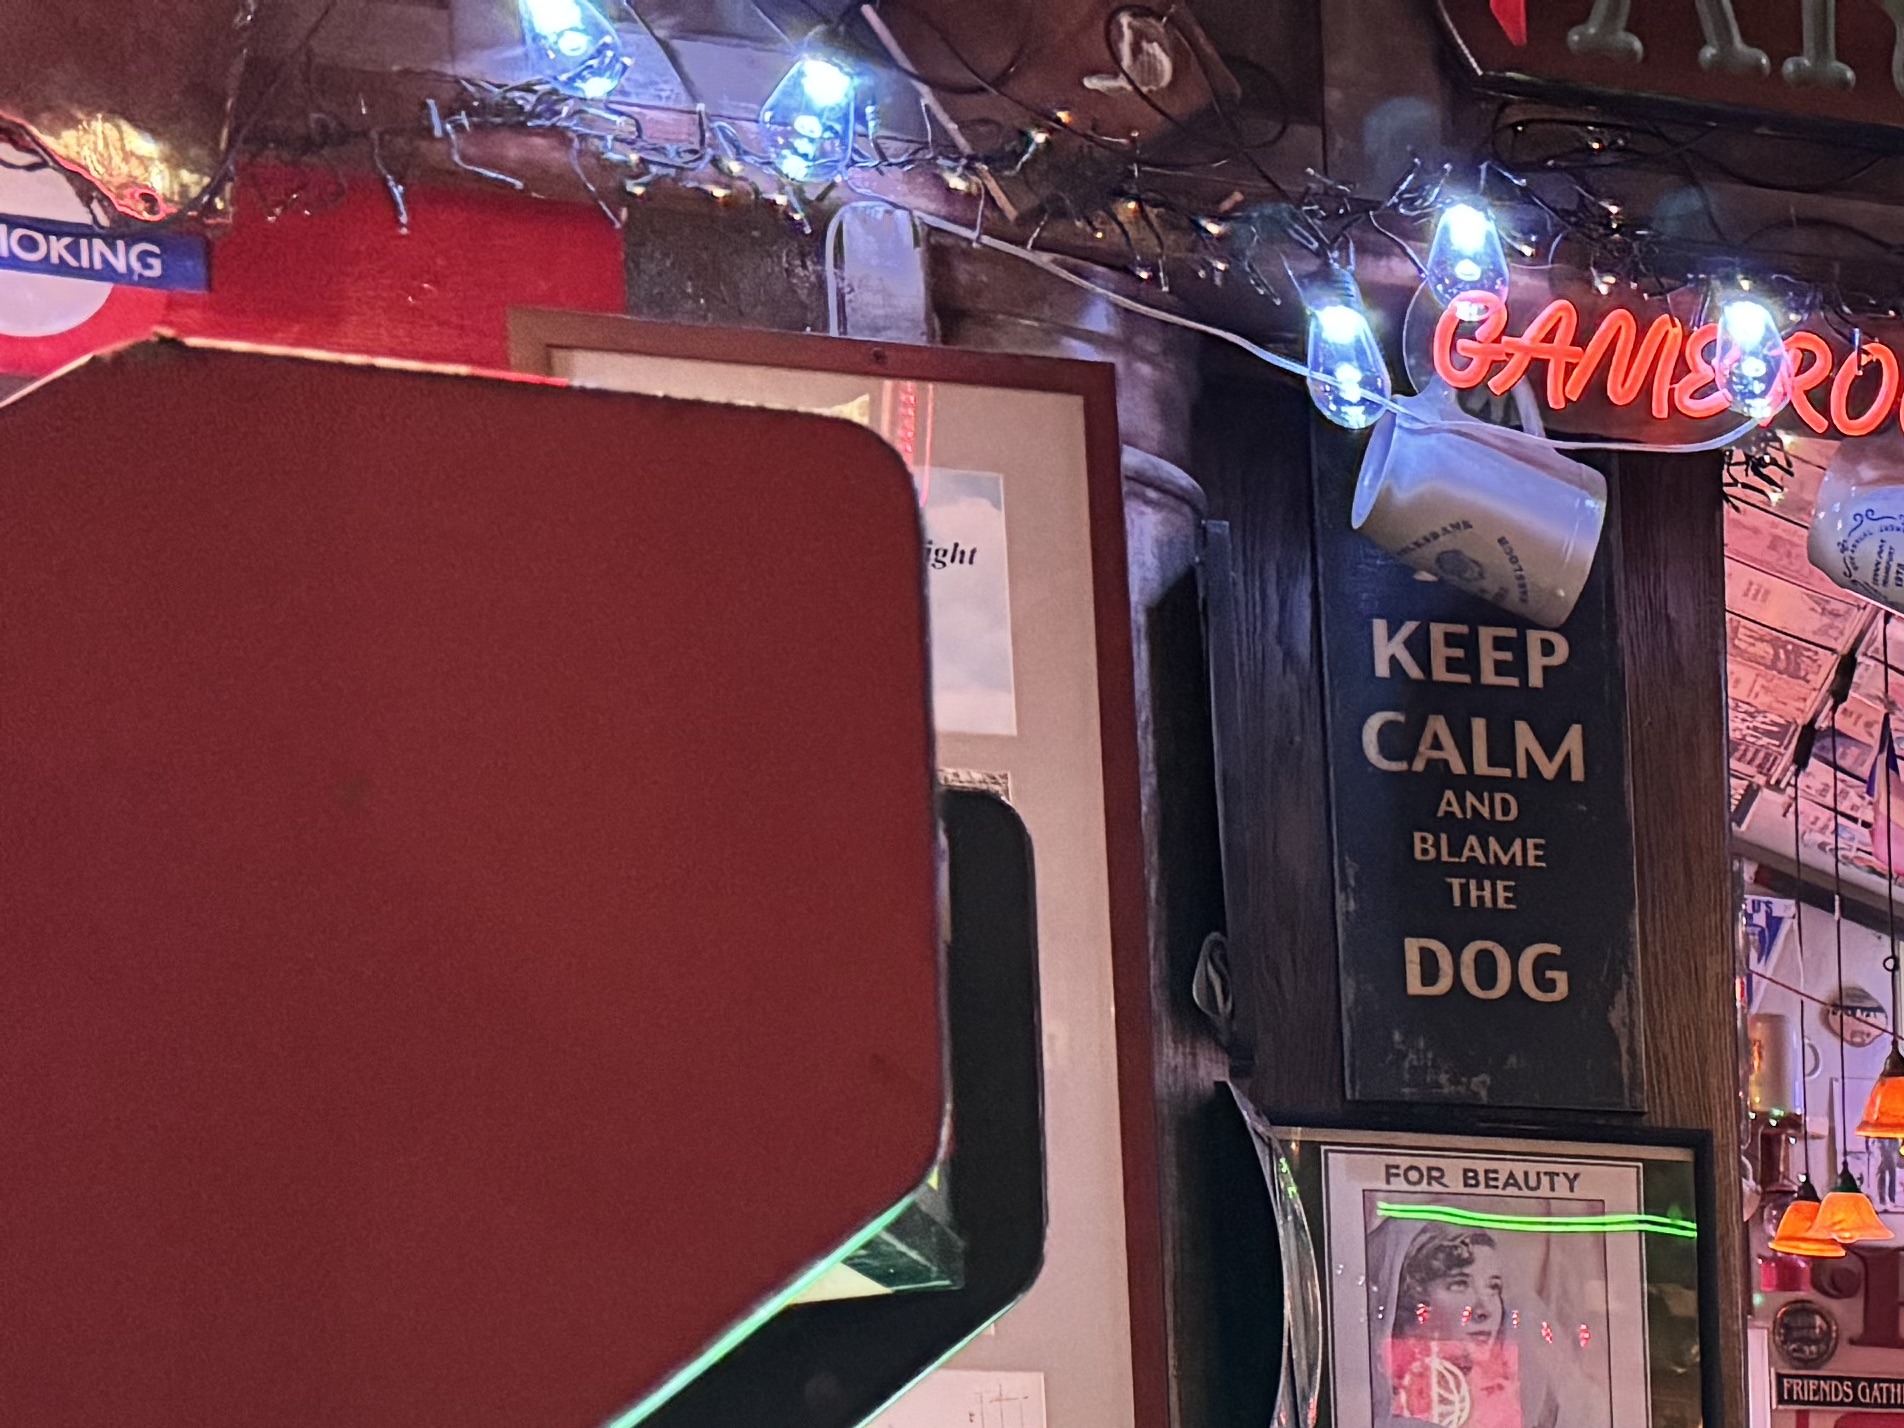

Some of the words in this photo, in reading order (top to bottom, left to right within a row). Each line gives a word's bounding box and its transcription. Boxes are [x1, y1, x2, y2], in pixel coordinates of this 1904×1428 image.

[1433, 290, 1737, 420] GAME
[1372, 618, 1570, 688] KEEP
[1361, 711, 1585, 783] CALM
[1436, 790, 1519, 822] AND
[1412, 831, 1547, 868] BLAME
[1445, 877, 1517, 910] THE
[1404, 936, 1570, 1002] DOG
[1384, 1164, 1450, 1188] FOR
[1462, 1166, 1581, 1194] BEAUTY
[1782, 1377, 1854, 1401] FRIENDS
